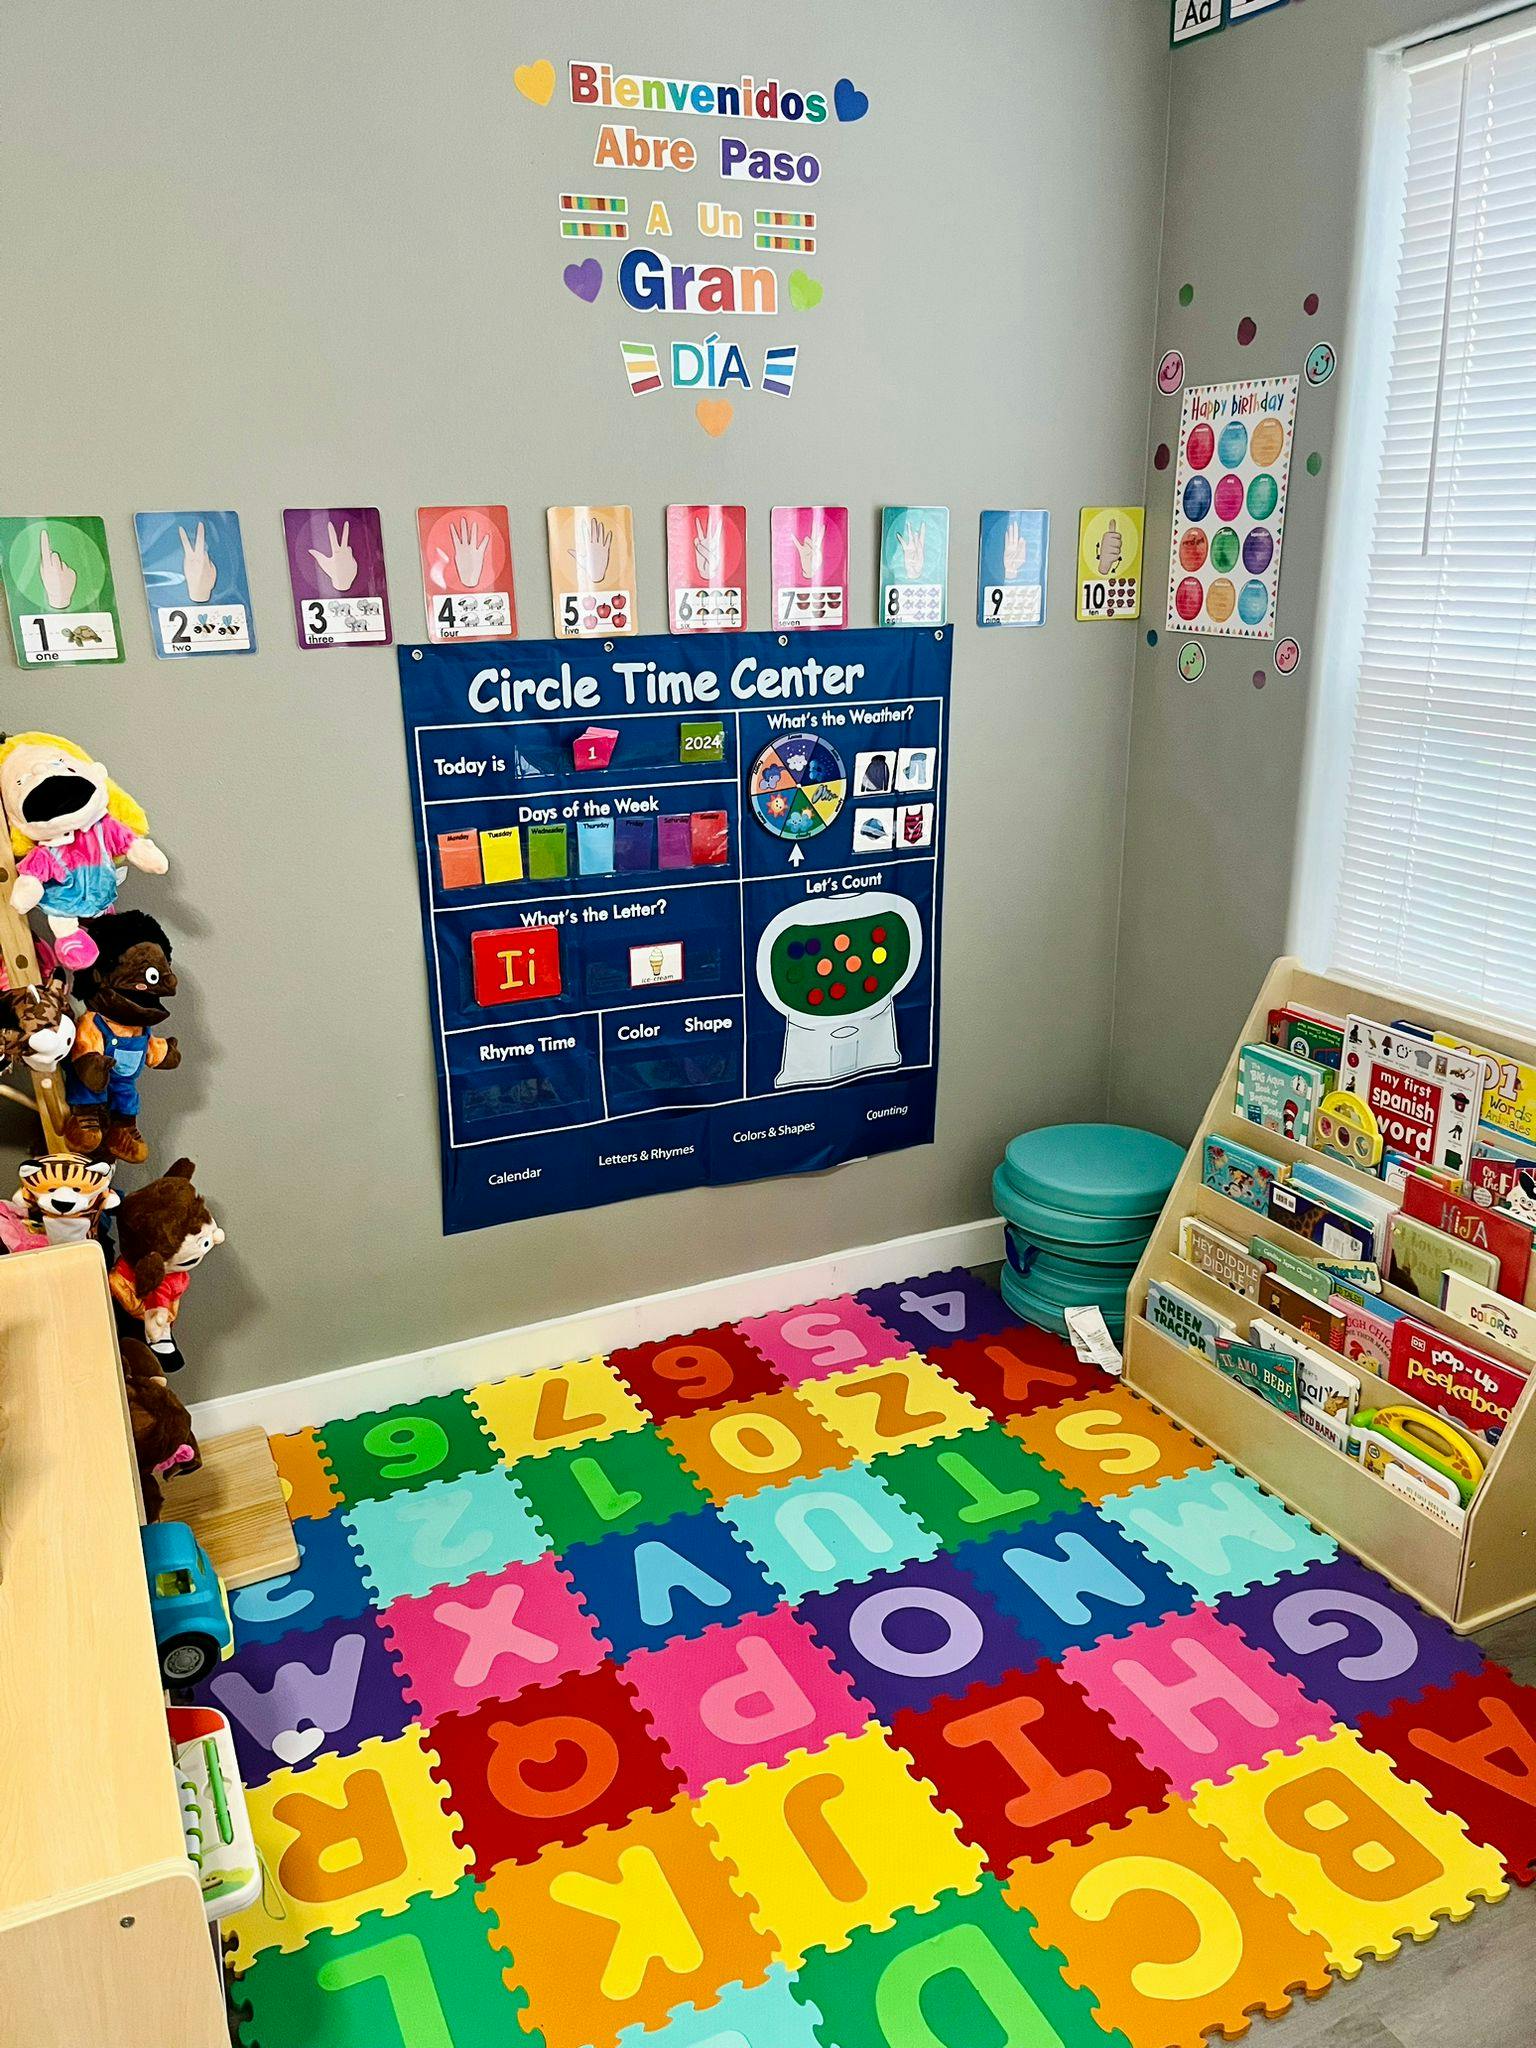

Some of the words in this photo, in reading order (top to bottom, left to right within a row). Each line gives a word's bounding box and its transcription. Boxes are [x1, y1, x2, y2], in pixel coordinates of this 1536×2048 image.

[570, 64, 827, 122] Bienvenidos
[596, 127, 695, 170] Abre
[721, 138, 820, 183] Paso
[647, 203, 670, 235] A
[699, 204, 741, 236] Un
[620, 249, 775, 312] Gran
[672, 333, 751, 387] DÍA
[1191, 395, 1226, 420] Happy
[564, 596, 579, 625] 5
[679, 593, 693, 620] 6
[781, 591, 796, 619] 7
[887, 588, 900, 615] 8
[991, 588, 1004, 615] 9
[1083, 583, 1105, 609] 10
[169, 610, 191, 643] 2
[309, 602, 327, 634] 3
[438, 598, 456, 628] 4
[33, 618, 49, 651] 1
[308, 634, 334, 644] three
[440, 628, 459, 638] four
[564, 625, 579, 635] five
[36, 652, 59, 661] one
[172, 644, 192, 652] two
[468, 663, 600, 714] Circle
[611, 662, 721, 705] Time
[730, 656, 865, 698] Center
[767, 712, 818, 730] What's
[821, 710, 845, 726] the
[849, 705, 914, 726] Weather?
[588, 746, 597, 759] 1
[684, 734, 722, 751] 2024
[433, 757, 487, 777] Today
[492, 755, 505, 772] is
[518, 804, 558, 824] Days
[562, 800, 580, 818] of
[583, 799, 611, 817] the
[614, 795, 660, 814] Week
[583, 822, 610, 830] Thursday
[664, 817, 690, 825] Saturday
[488, 830, 512, 839] Tuesday
[531, 826, 565, 835] Wednesday
[806, 878, 838, 894] Let's
[841, 872, 883, 889] Count
[520, 909, 578, 928] What's
[583, 906, 609, 923] the
[613, 899, 667, 919] Letter?
[497, 948, 535, 990] Ii
[617, 1023, 661, 1041] Color
[684, 1017, 732, 1033] Shape
[479, 1042, 535, 1061] Rhyme
[538, 1035, 576, 1053] Time
[1380, 1070, 1400, 1089] my
[1404, 1077, 1432, 1099] first
[866, 1103, 908, 1121] Counting
[1372, 1086, 1435, 1123] spanish
[733, 1129, 766, 1144] Colors
[768, 1127, 777, 1138] &
[778, 1121, 815, 1138] Shapes
[1377, 1114, 1433, 1153] word
[598, 1150, 637, 1167] Letters
[640, 1150, 649, 1162] &
[650, 1143, 695, 1162] Rhymes
[488, 1168, 542, 1186] Calendar
[1192, 1234, 1214, 1254] HEY
[1216, 1249, 1258, 1282] DIDDLE
[1203, 1253, 1245, 1286] DIDDLE
[900, 1290, 965, 1332] 4
[1158, 1296, 1202, 1333] GREEN
[1471, 1306, 1518, 1339] COLORES
[780, 1313, 867, 1366] 5
[1153, 1308, 1206, 1354] TRACTOR
[1412, 1338, 1425, 1351] DK
[984, 1345, 1077, 1401] Y
[1407, 1358, 1512, 1422] peekaboo
[1055, 1409, 1161, 1474] S
[1315, 1421, 1336, 1442] BARN
[936, 1452, 1040, 1523] T
[774, 1492, 893, 1572] U
[1003, 1532, 1145, 1625] N
[433, 1584, 559, 1688] X
[849, 1586, 983, 1677] O
[1273, 1589, 1418, 1681] G
[700, 1636, 817, 1745] P
[1112, 1637, 1279, 1753] H
[942, 1696, 1112, 1828] I
[1408, 1697, 1536, 1806] A
[272, 1768, 408, 1903] R
[783, 1773, 867, 1902] J
[1264, 1767, 1444, 1901] B
[549, 1845, 704, 2000] K
[1070, 1856, 1243, 2001] C
[875, 1923, 1068, 2048] D
